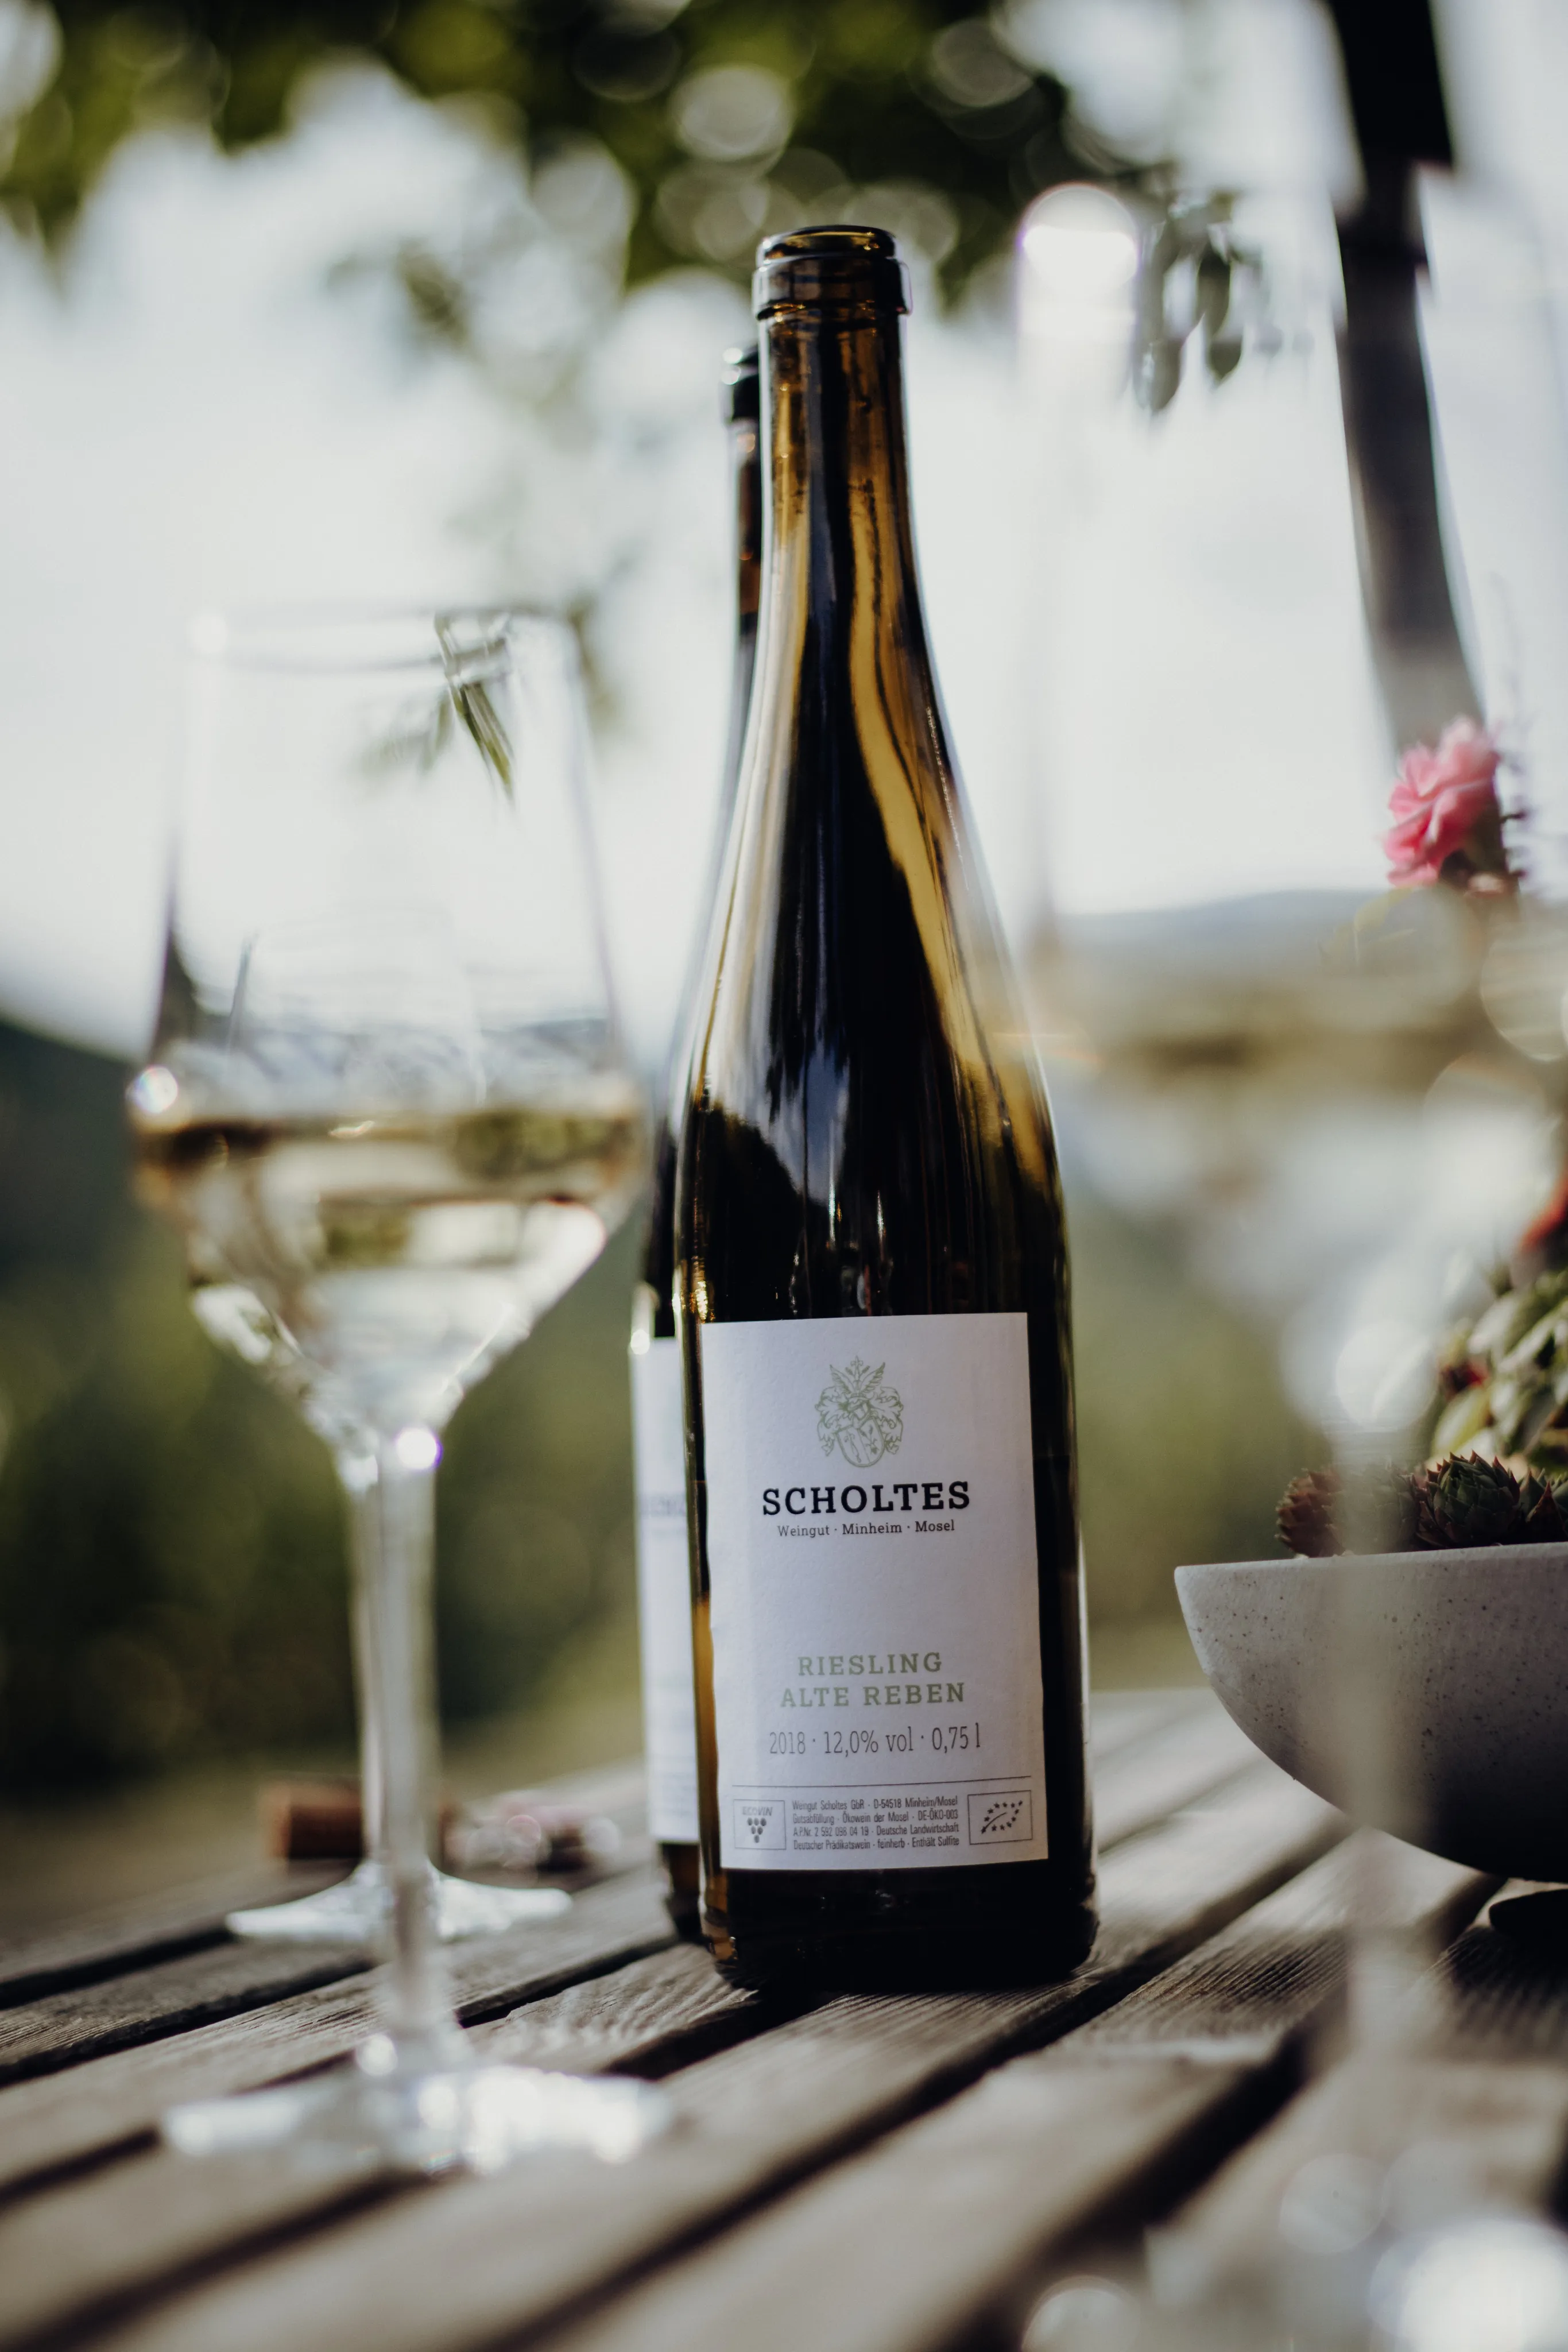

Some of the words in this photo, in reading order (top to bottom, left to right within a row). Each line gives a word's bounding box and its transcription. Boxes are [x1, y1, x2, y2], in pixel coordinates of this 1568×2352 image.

[763, 1481, 970, 1515] SCHOLTES
[777, 1525, 830, 1538] Weingut
[842, 1522, 902, 1535] Minheim
[915, 1519, 955, 1533] Mosel
[798, 1652, 942, 1676] RIESLING
[780, 1687, 849, 1707] ALTE
[863, 1682, 964, 1706] REBEN
[769, 1731, 806, 1754] 2018
[824, 1730, 878, 1757] 12,0%
[885, 1726, 913, 1751] vol
[931, 1726, 969, 1754] 0,75
[742, 1806, 773, 1816] ECOVIN
[792, 1800, 817, 1812] Weingut
[820, 1800, 847, 1810] Scholtes
[851, 1799, 865, 1809] GbR
[873, 1798, 902, 1809] D-54518
[793, 1813, 834, 1825] Gutsabfüllung
[842, 1812, 871, 1823] Ökowein
[874, 1812, 885, 1823] der
[888, 1811, 909, 1821] Mosel
[815, 1827, 819, 1836] 2
[850, 1826, 858, 1836] 04
[861, 1826, 869, 1836] 19
[876, 1825, 907, 1835] Deutsche
[910, 1822, 959, 1834] Landwirtschaft
[793, 1839, 823, 1850] Deutscher
[826, 1839, 870, 1850] Prädikatswein
[877, 1838, 905, 1848] feinherb
[912, 1836, 935, 1847] Enthält
